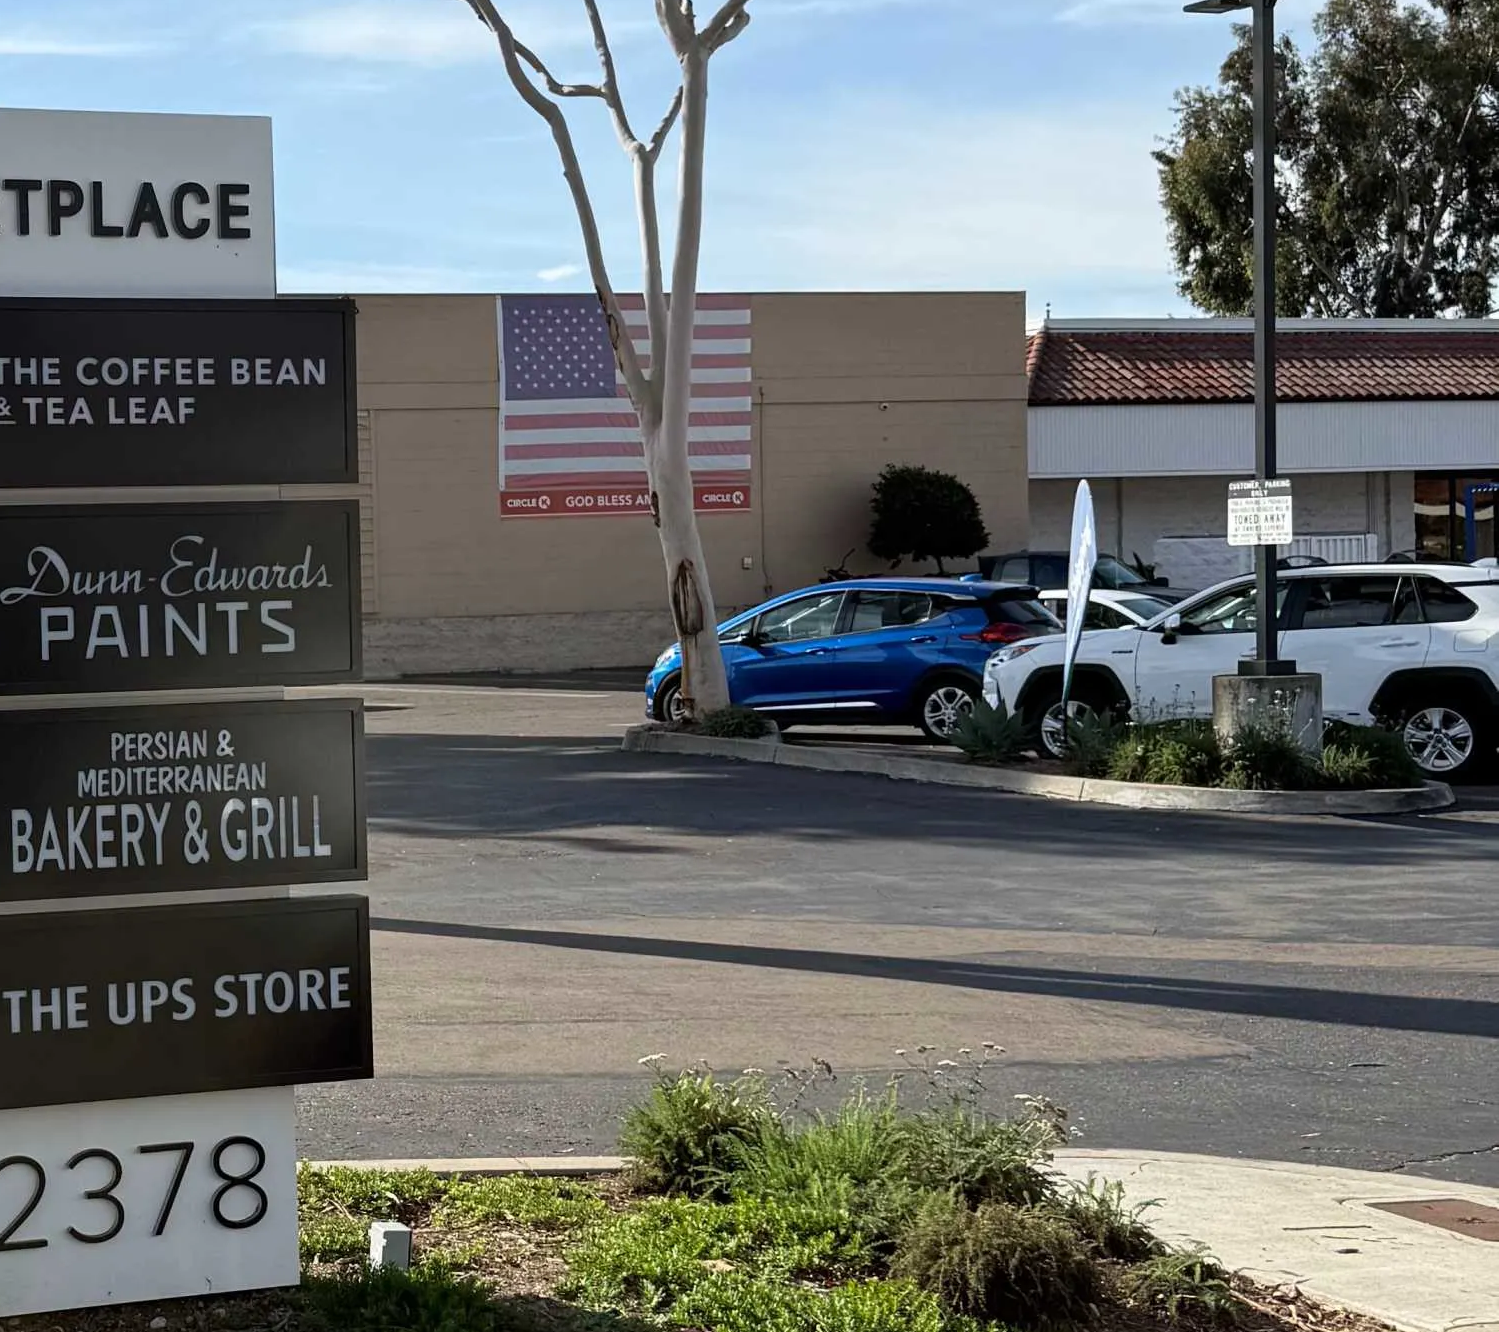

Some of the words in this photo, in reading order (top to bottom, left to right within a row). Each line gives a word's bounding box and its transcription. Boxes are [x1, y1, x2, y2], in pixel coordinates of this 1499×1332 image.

[75, 357, 216, 386] COFFEE
[230, 357, 327, 386] BEAN
[22, 397, 94, 425] TEA
[107, 396, 197, 425] LEAF
[507, 498, 538, 508] CIRCLE
[565, 495, 594, 508] GOD
[597, 494, 633, 507] BLESS
[702, 494, 732, 503] CIRCLE
[1234, 515, 1259, 524] TOWED
[1264, 514, 1286, 524] AWAY
[39, 599, 297, 662] PAINTS
[110, 731, 208, 763] PERSIAN
[216, 729, 235, 757] &
[77, 761, 268, 798] MEDITERRANEAN
[10, 801, 168, 874] BAKERY
[183, 799, 211, 865] &
[219, 794, 333, 862] GRILL
[2, 985, 89, 1034] THE
[107, 977, 196, 1025] UPS
[213, 966, 352, 1019] STORE
